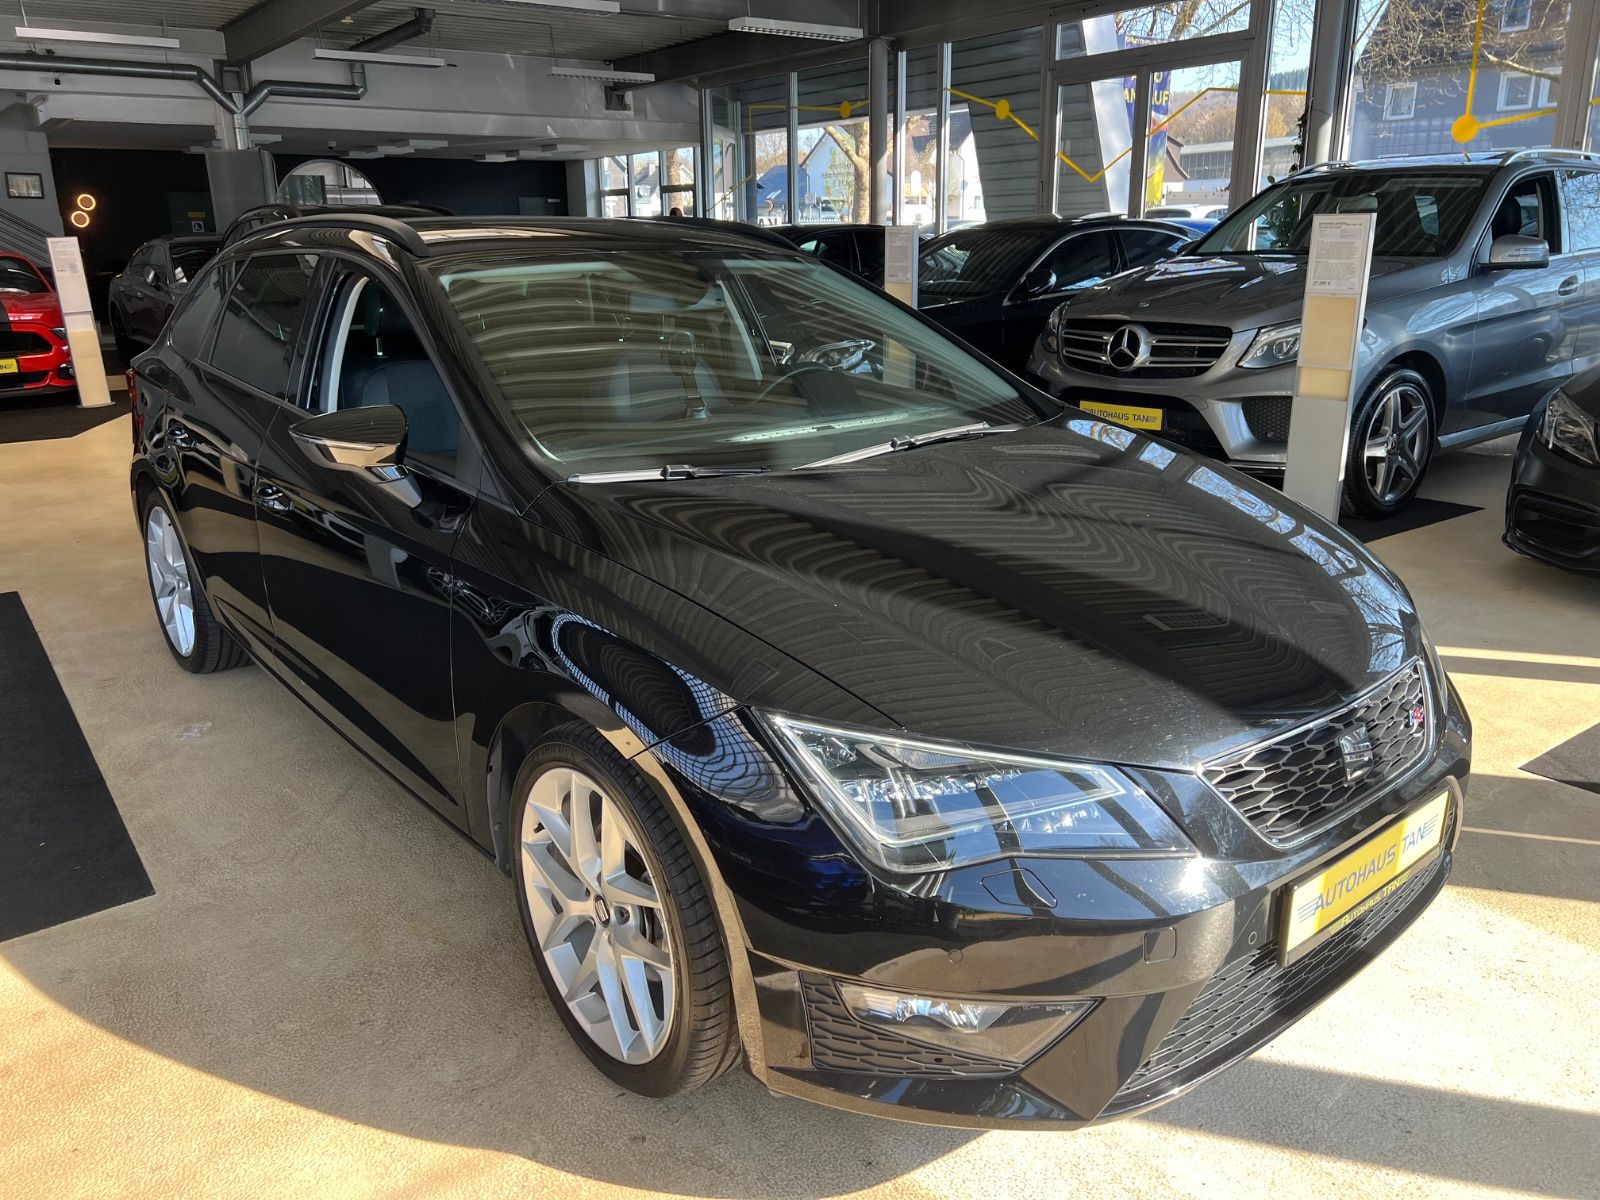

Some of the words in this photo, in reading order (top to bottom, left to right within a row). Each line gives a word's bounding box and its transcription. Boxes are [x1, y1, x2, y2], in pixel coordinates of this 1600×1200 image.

[1131, 413, 1150, 423] TAN
[1313, 843, 1398, 917] AUTOHAUS
[1402, 825, 1427, 854] TAN
